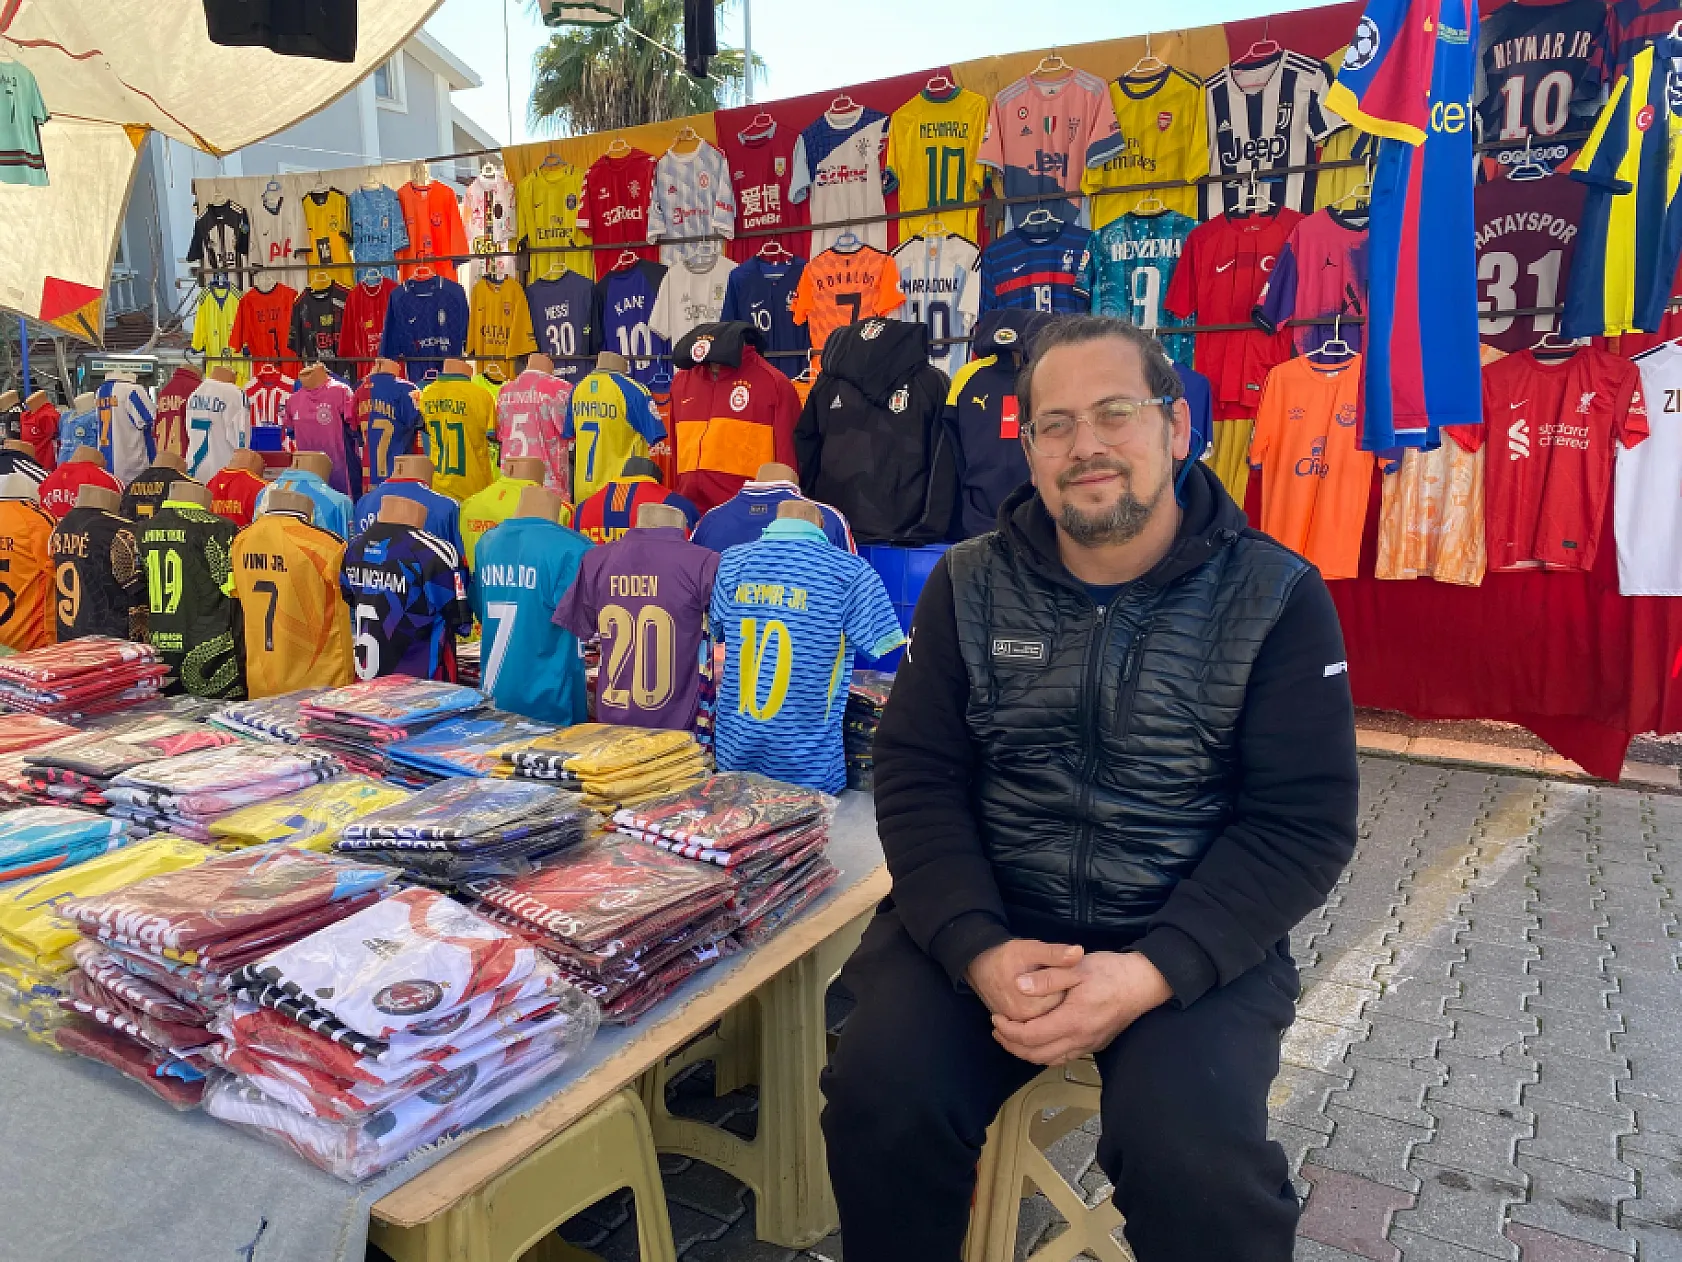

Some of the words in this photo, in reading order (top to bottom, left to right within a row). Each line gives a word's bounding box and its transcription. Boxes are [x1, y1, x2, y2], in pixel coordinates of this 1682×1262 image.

[1493, 32, 1566, 69] NEYMAR
[1567, 30, 1593, 58] JR
[1499, 70, 1573, 140] 10
[926, 145, 967, 209] 10
[1222, 133, 1287, 167] Jeep
[900, 277, 958, 294] MARADONA
[1032, 284, 1052, 315] 19
[1131, 266, 1161, 331] 9
[1477, 249, 1563, 336] 31
[545, 321, 576, 357] 30
[616, 321, 652, 370] 10
[750, 308, 773, 333] 10
[156, 415, 182, 454] 14
[187, 418, 213, 478] 7
[509, 411, 529, 457] 5
[579, 420, 601, 483] 7
[148, 548, 183, 614] 19
[243, 553, 267, 573] VINI
[610, 574, 659, 598] FODEN
[56, 560, 82, 627] 9
[251, 580, 279, 653] 7
[734, 583, 785, 606] NEYMAR
[353, 602, 380, 681] 5
[482, 601, 519, 698] 7
[598, 603, 677, 711] 20
[738, 617, 793, 722] 10
